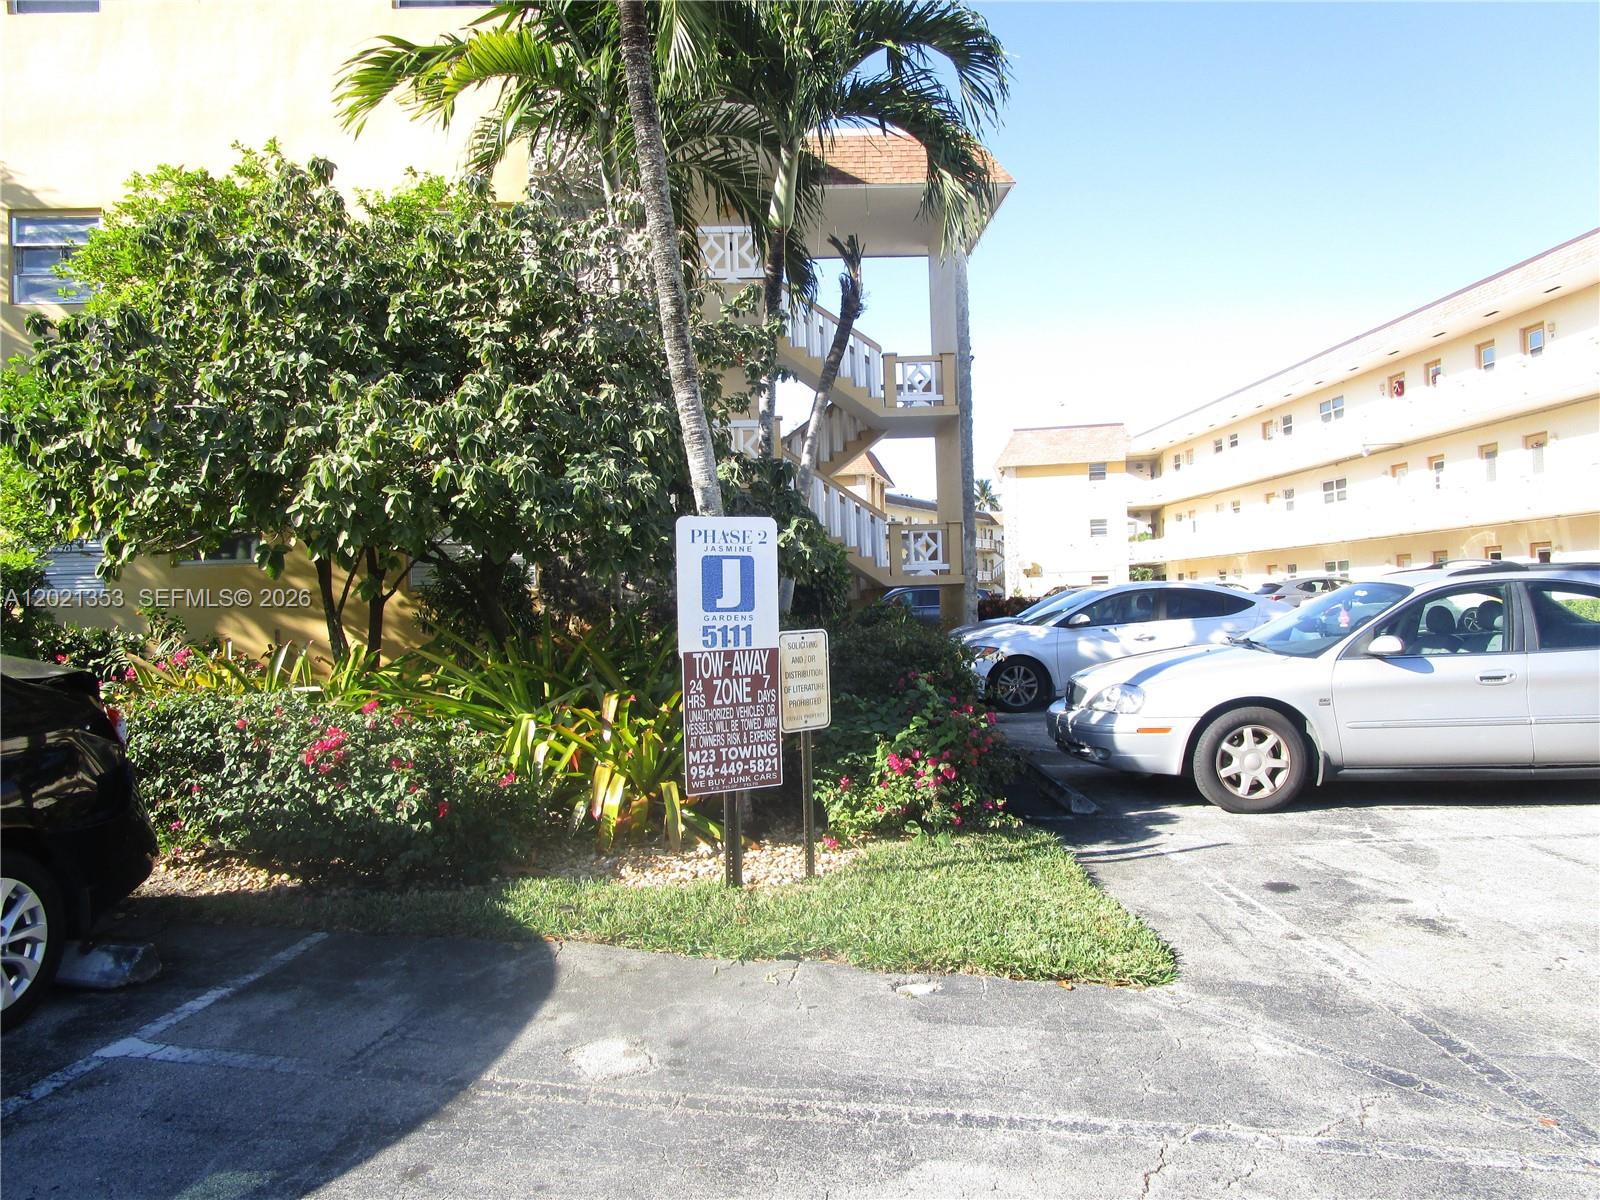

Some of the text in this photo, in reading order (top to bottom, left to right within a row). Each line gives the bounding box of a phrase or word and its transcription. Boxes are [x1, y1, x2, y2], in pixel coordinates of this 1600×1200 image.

[691, 529, 767, 544] PHASE 2
[716, 559, 740, 608] J
[702, 624, 752, 648] 5111
[787, 641, 818, 650] SOLICITING
[692, 650, 770, 679] TOW-AWAY
[762, 675, 771, 689] 7
[784, 668, 823, 680] DISTRIBUTION
[690, 680, 703, 694] 24
[713, 677, 752, 705] ZONE
[783, 683, 825, 694] OF LITERATURE
[687, 693, 706, 709] HRS
[757, 689, 777, 703] DAYS
[788, 698, 821, 708] PROHIBITED
[688, 704, 775, 723] UNAUTHORIZED VEHICLES OR
[686, 716, 778, 735] VESSELS WILL BE TOWED AWAY
[689, 729, 776, 749] AT OWNERS RISK & EXPENSE
[688, 743, 778, 764] M23 TOWING
[690, 758, 778, 779] 954-449-5821
[691, 780, 705, 788] WE
[708, 778, 726, 787] BUY
[728, 775, 751, 784] JUNK
[753, 773, 777, 781] CARS
